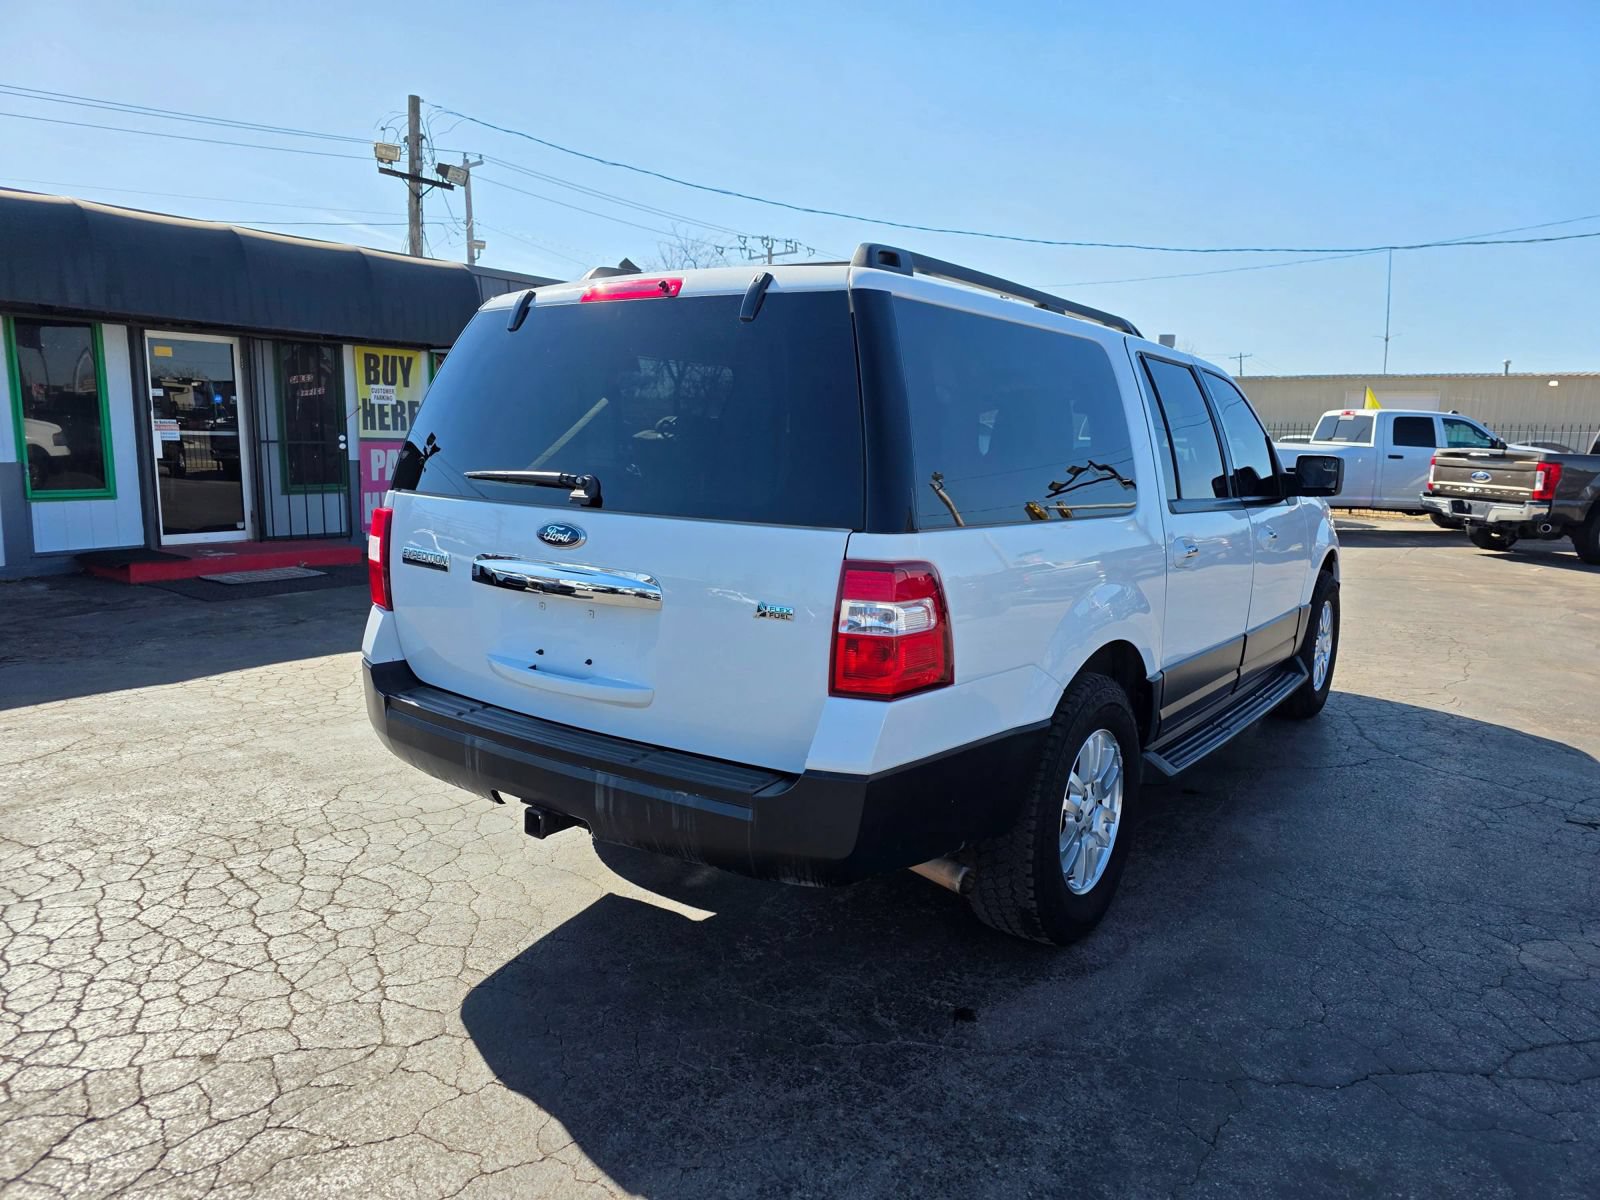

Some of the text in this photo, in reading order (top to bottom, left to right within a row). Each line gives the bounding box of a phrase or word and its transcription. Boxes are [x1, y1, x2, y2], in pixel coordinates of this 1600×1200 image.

[364, 353, 413, 388] BUY
[371, 449, 401, 481] PA
[544, 525, 571, 543] Ford
[403, 548, 449, 566] EXPEDITION
[769, 606, 792, 614] FLEX
[769, 612, 792, 620] FUEL
